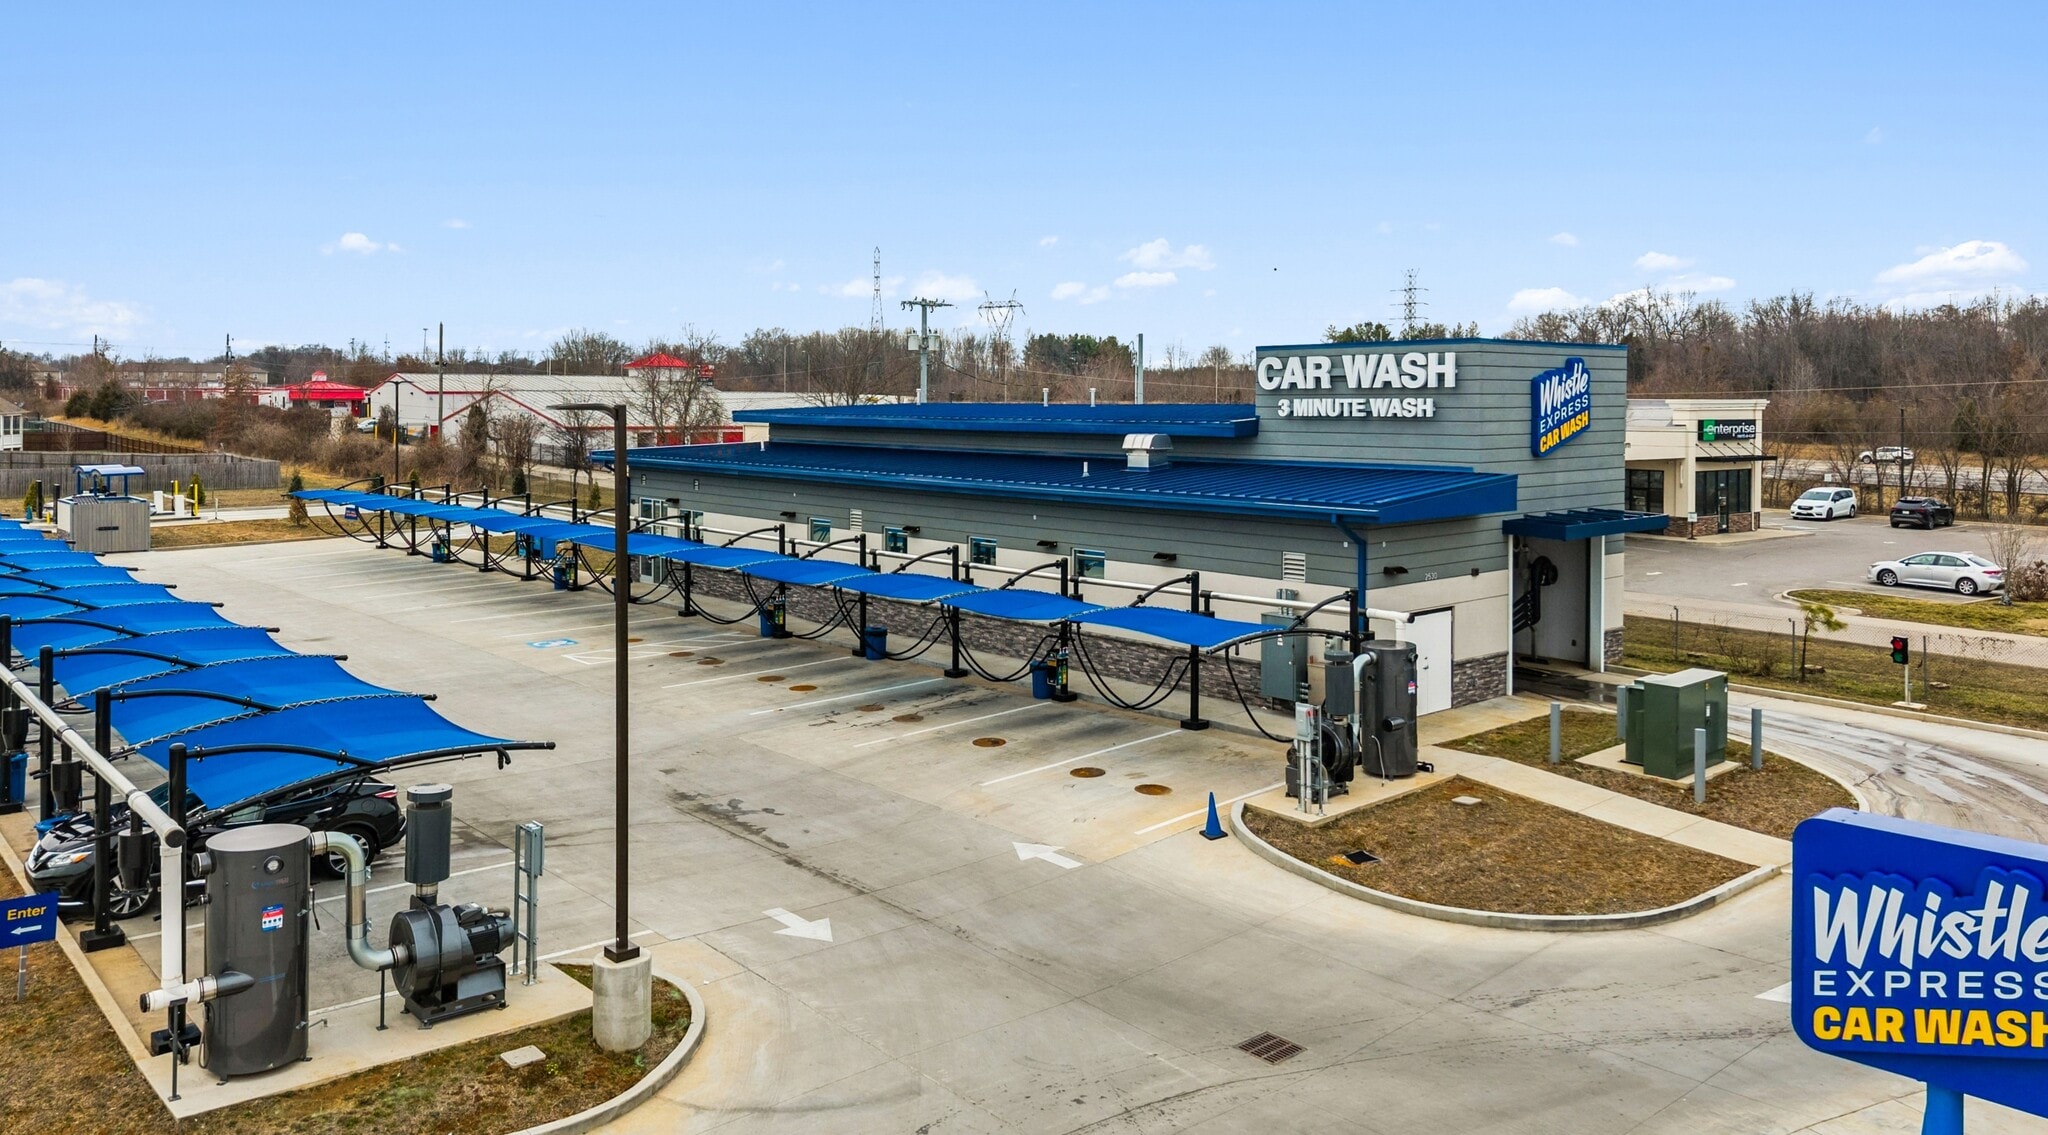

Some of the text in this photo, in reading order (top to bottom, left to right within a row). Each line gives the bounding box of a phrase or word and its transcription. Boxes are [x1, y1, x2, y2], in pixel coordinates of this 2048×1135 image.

[1257, 352, 1456, 391] CAR WASH
[1540, 362, 1589, 417] Whistle
[1277, 398, 1434, 417] 3 MINUTE WASH
[1540, 394, 1589, 433] EXPRESS
[1540, 410, 1589, 453] CAR WASH
[1704, 422, 1755, 437] enterprise
[7, 906, 47, 921] Enter
[1813, 879, 2048, 970] Whistle
[1813, 1005, 1906, 1043] CAR
